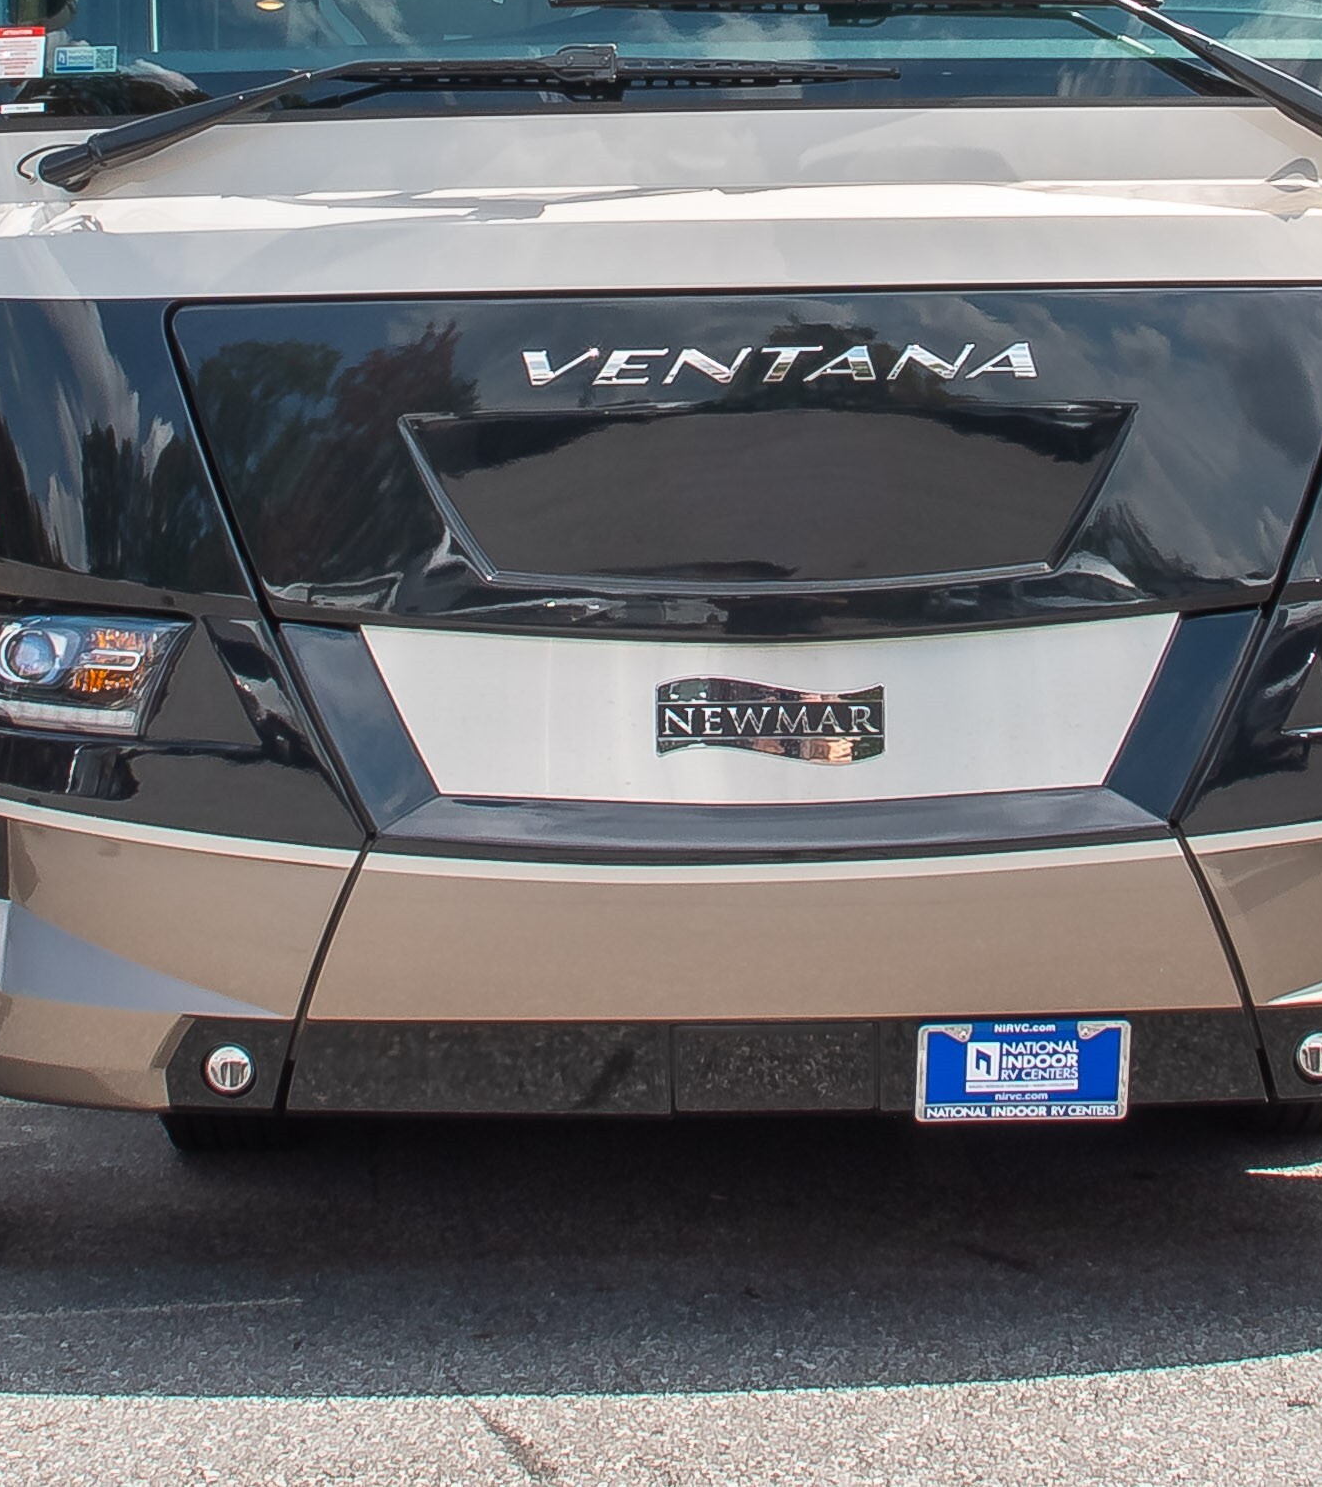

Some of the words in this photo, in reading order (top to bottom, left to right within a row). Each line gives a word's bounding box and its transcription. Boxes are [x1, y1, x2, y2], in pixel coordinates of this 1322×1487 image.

[520, 341, 1040, 387] VENTANA
[661, 705, 881, 735] NEWMAR
[994, 1023, 1056, 1033] NIRVC.com
[1002, 1040, 1079, 1054] NATIONAL
[1001, 1054, 1079, 1069] INDOOR
[1001, 1069, 1019, 1081] RV
[1021, 1068, 1079, 1081] CENTERS
[994, 1092, 1049, 1101] nirvc.com
[927, 1107, 987, 1118] NATIONAL
[991, 1106, 1047, 1117] INDOOR
[1051, 1106, 1067, 1116] RV
[1068, 1105, 1117, 1116] CENTERS
